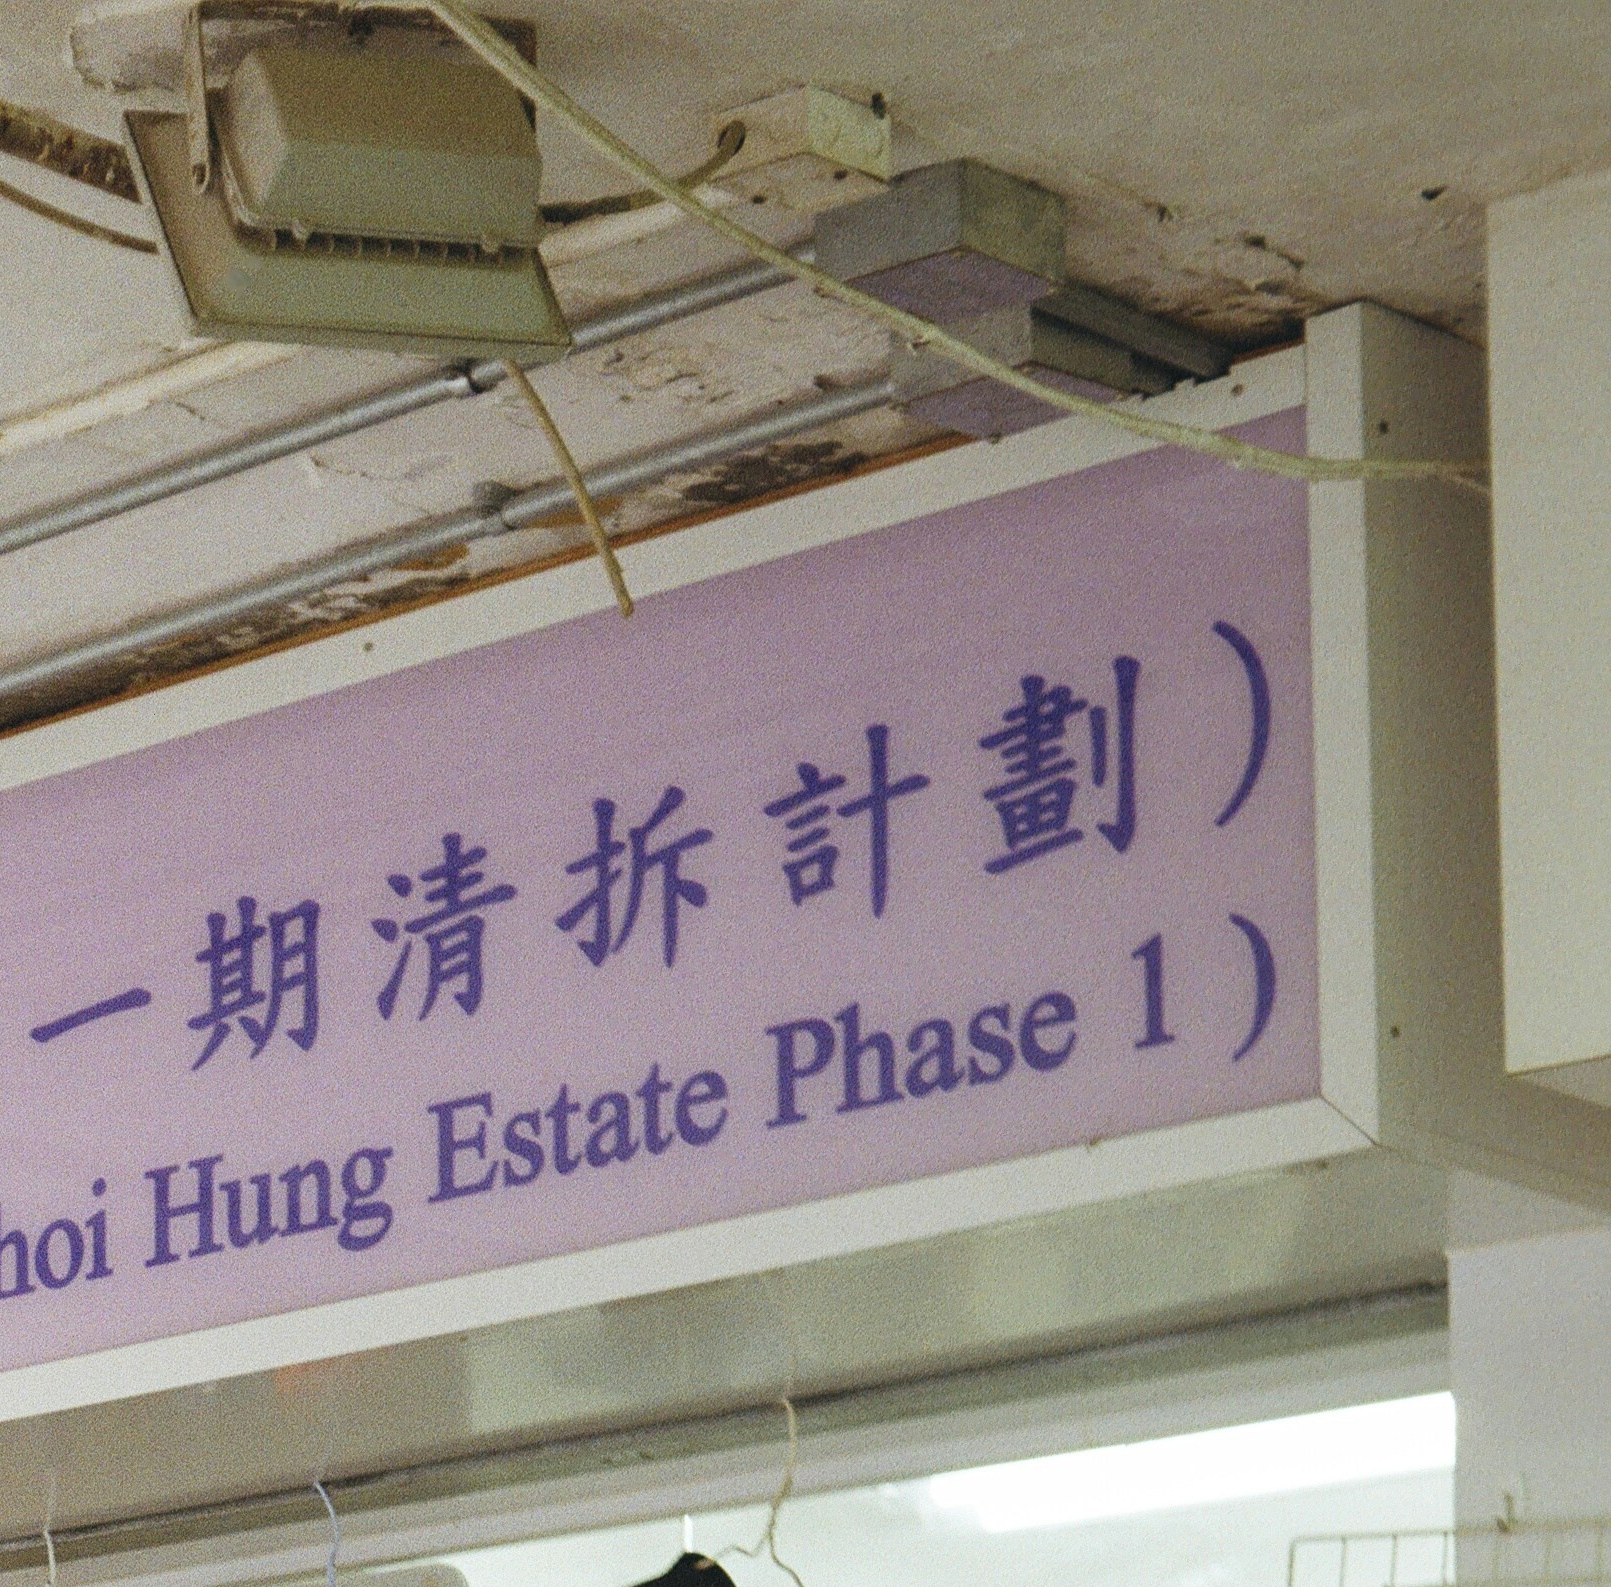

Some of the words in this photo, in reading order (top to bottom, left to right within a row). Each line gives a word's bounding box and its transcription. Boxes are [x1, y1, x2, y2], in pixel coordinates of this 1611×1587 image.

[142, 1128, 398, 1271] Hung
[428, 1056, 728, 1205] Estate
[764, 975, 1080, 1133] Phase
